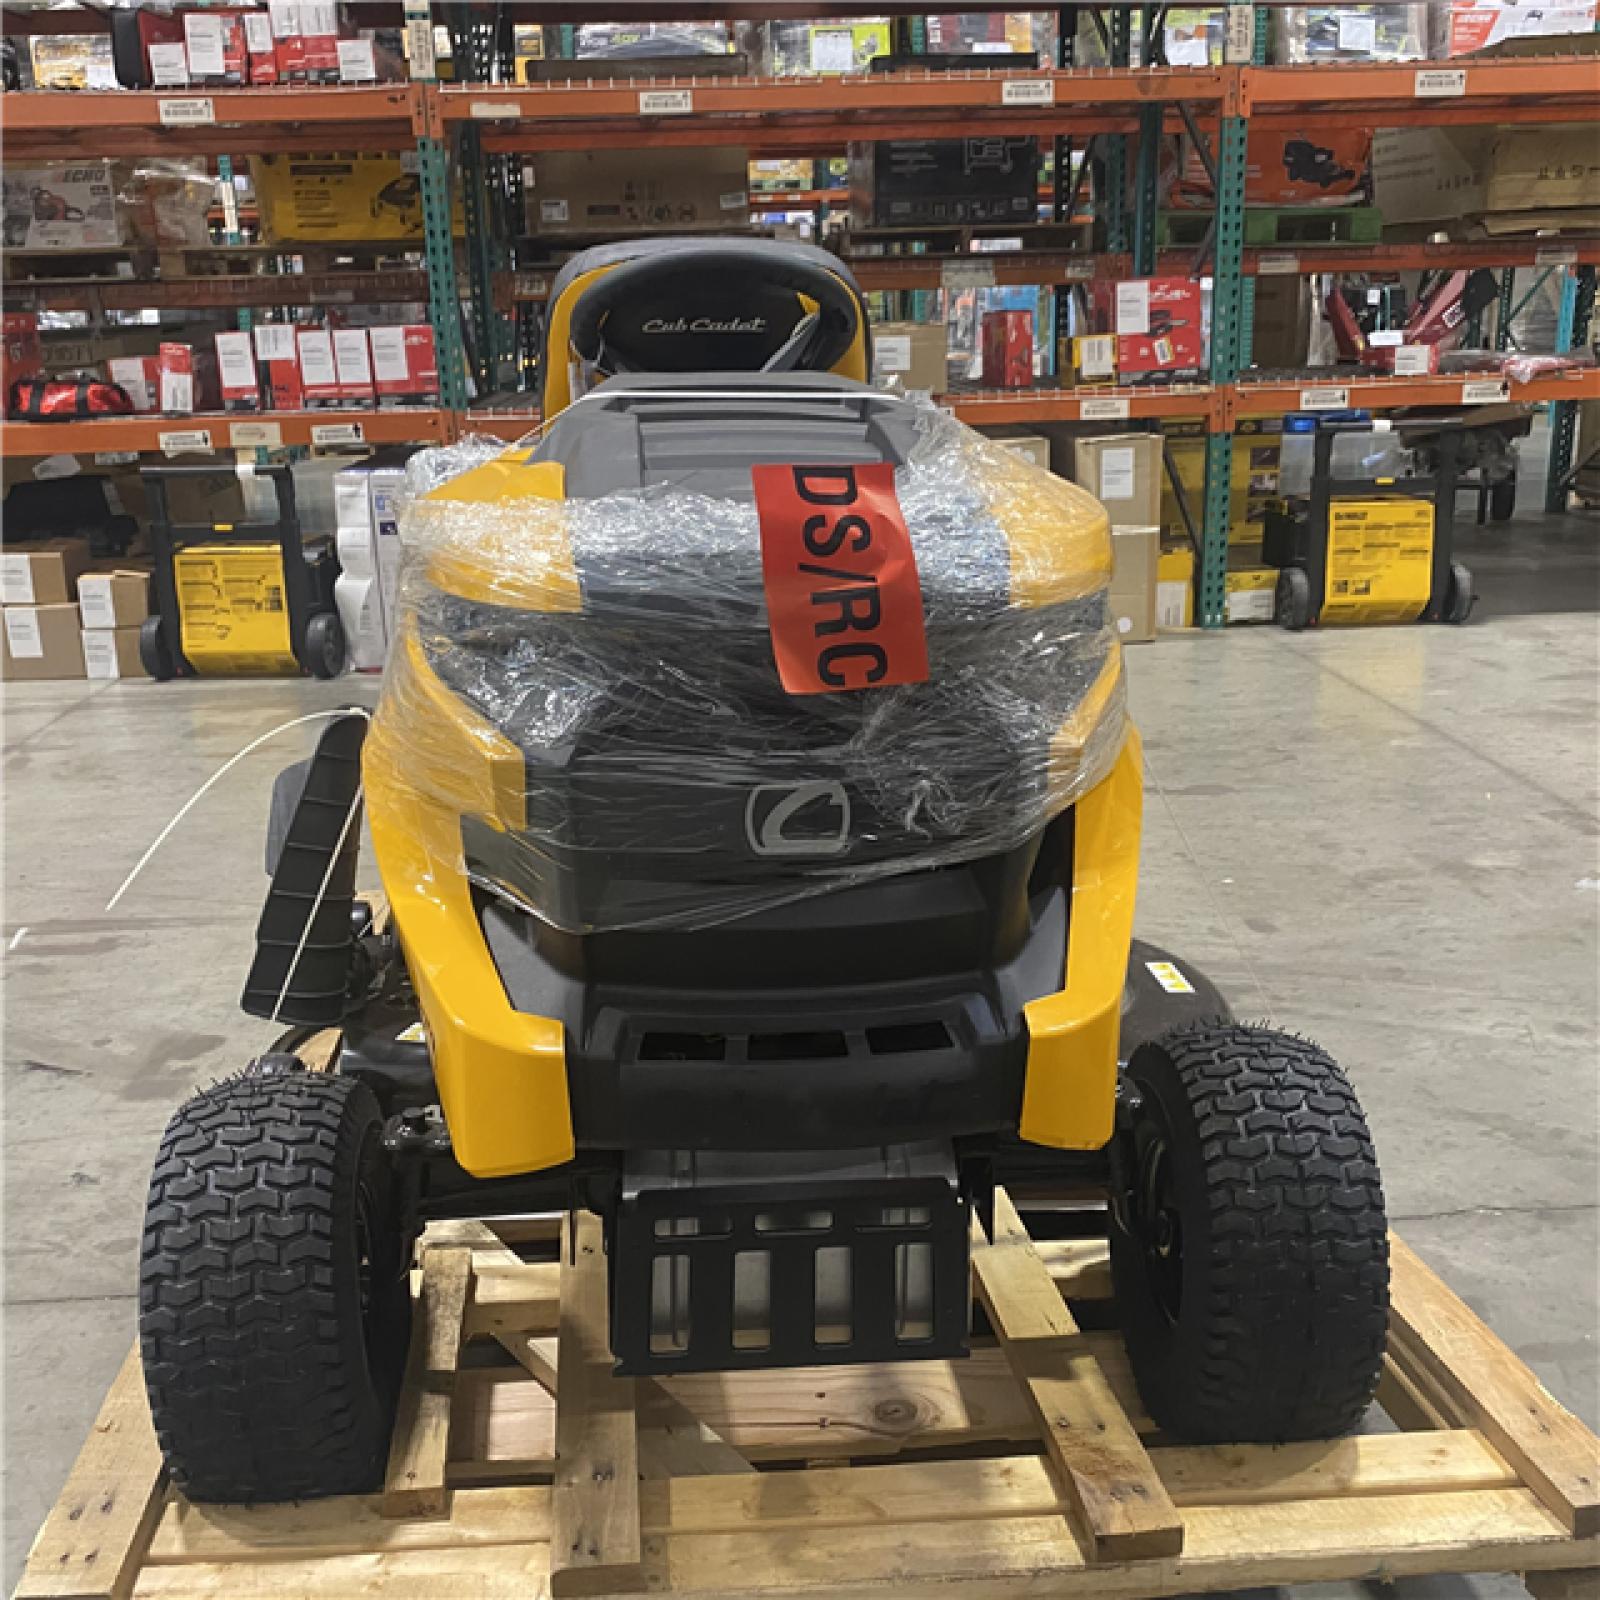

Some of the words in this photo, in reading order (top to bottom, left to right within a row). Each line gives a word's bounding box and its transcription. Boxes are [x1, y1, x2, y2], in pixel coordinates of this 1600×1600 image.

[642, 317, 688, 334] Cub
[690, 317, 766, 334] Cadet
[792, 465, 888, 686] DS/RC
